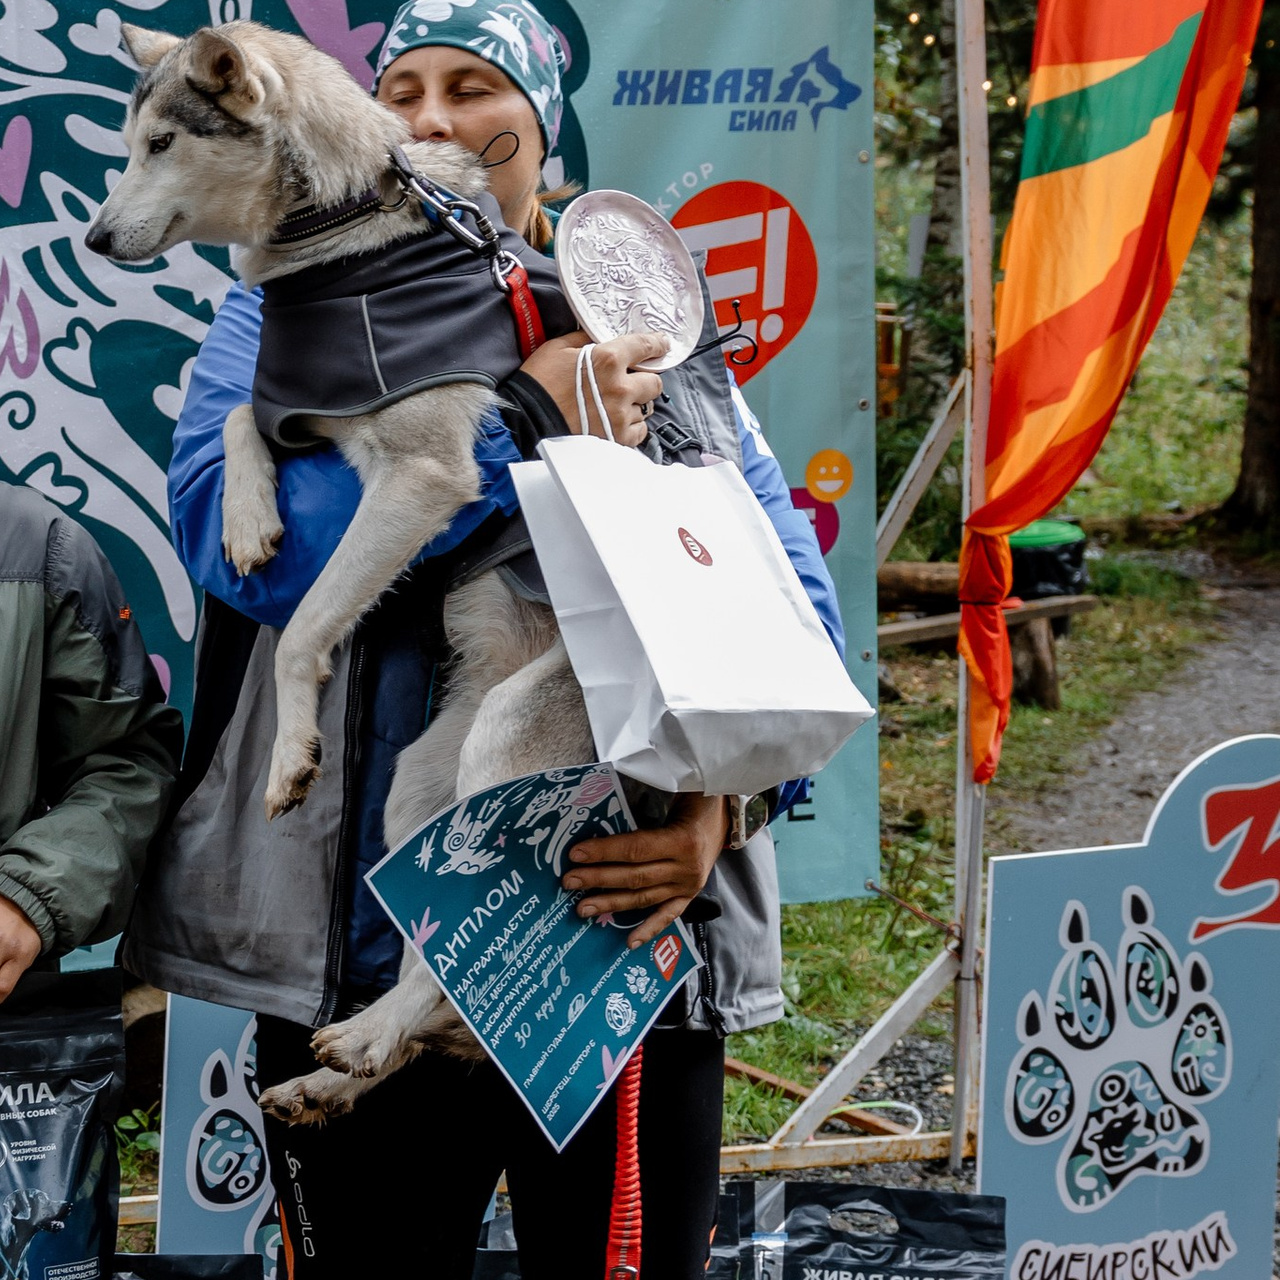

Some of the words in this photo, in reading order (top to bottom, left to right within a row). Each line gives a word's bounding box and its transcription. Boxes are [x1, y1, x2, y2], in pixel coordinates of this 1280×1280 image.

[612, 67, 775, 106] ЖИВАЯ
[729, 109, 797, 132] СИЛА
[653, 162, 714, 216] КТОР
[434, 870, 524, 981] ДИПЛОМ
[453, 894, 540, 999] НАГРАЖДАЕТСЯ
[473, 1010, 485, 1023] ЗА
[491, 967, 517, 1001] МЕСТО
[516, 959, 523, 969] В
[504, 974, 532, 1006] РАУНД
[591, 957, 622, 996] ВИКТОРИЯ
[489, 984, 539, 1049] ДИСЦИПЛИНА
[514, 1021, 532, 1049] 30
[523, 1051, 549, 1089] ГЛАВНЫЙ
[547, 1027, 567, 1054] СУДЬЯ
[569, 1045, 591, 1075] СЕКТОР
[27, 1107, 57, 1118] СОБАК
[10, 1139, 37, 1148] УРОВНЯ
[11, 1144, 57, 1155] ФИЗИЧЕСКОЙ
[12, 1153, 46, 1162] НАГРУЗКИ
